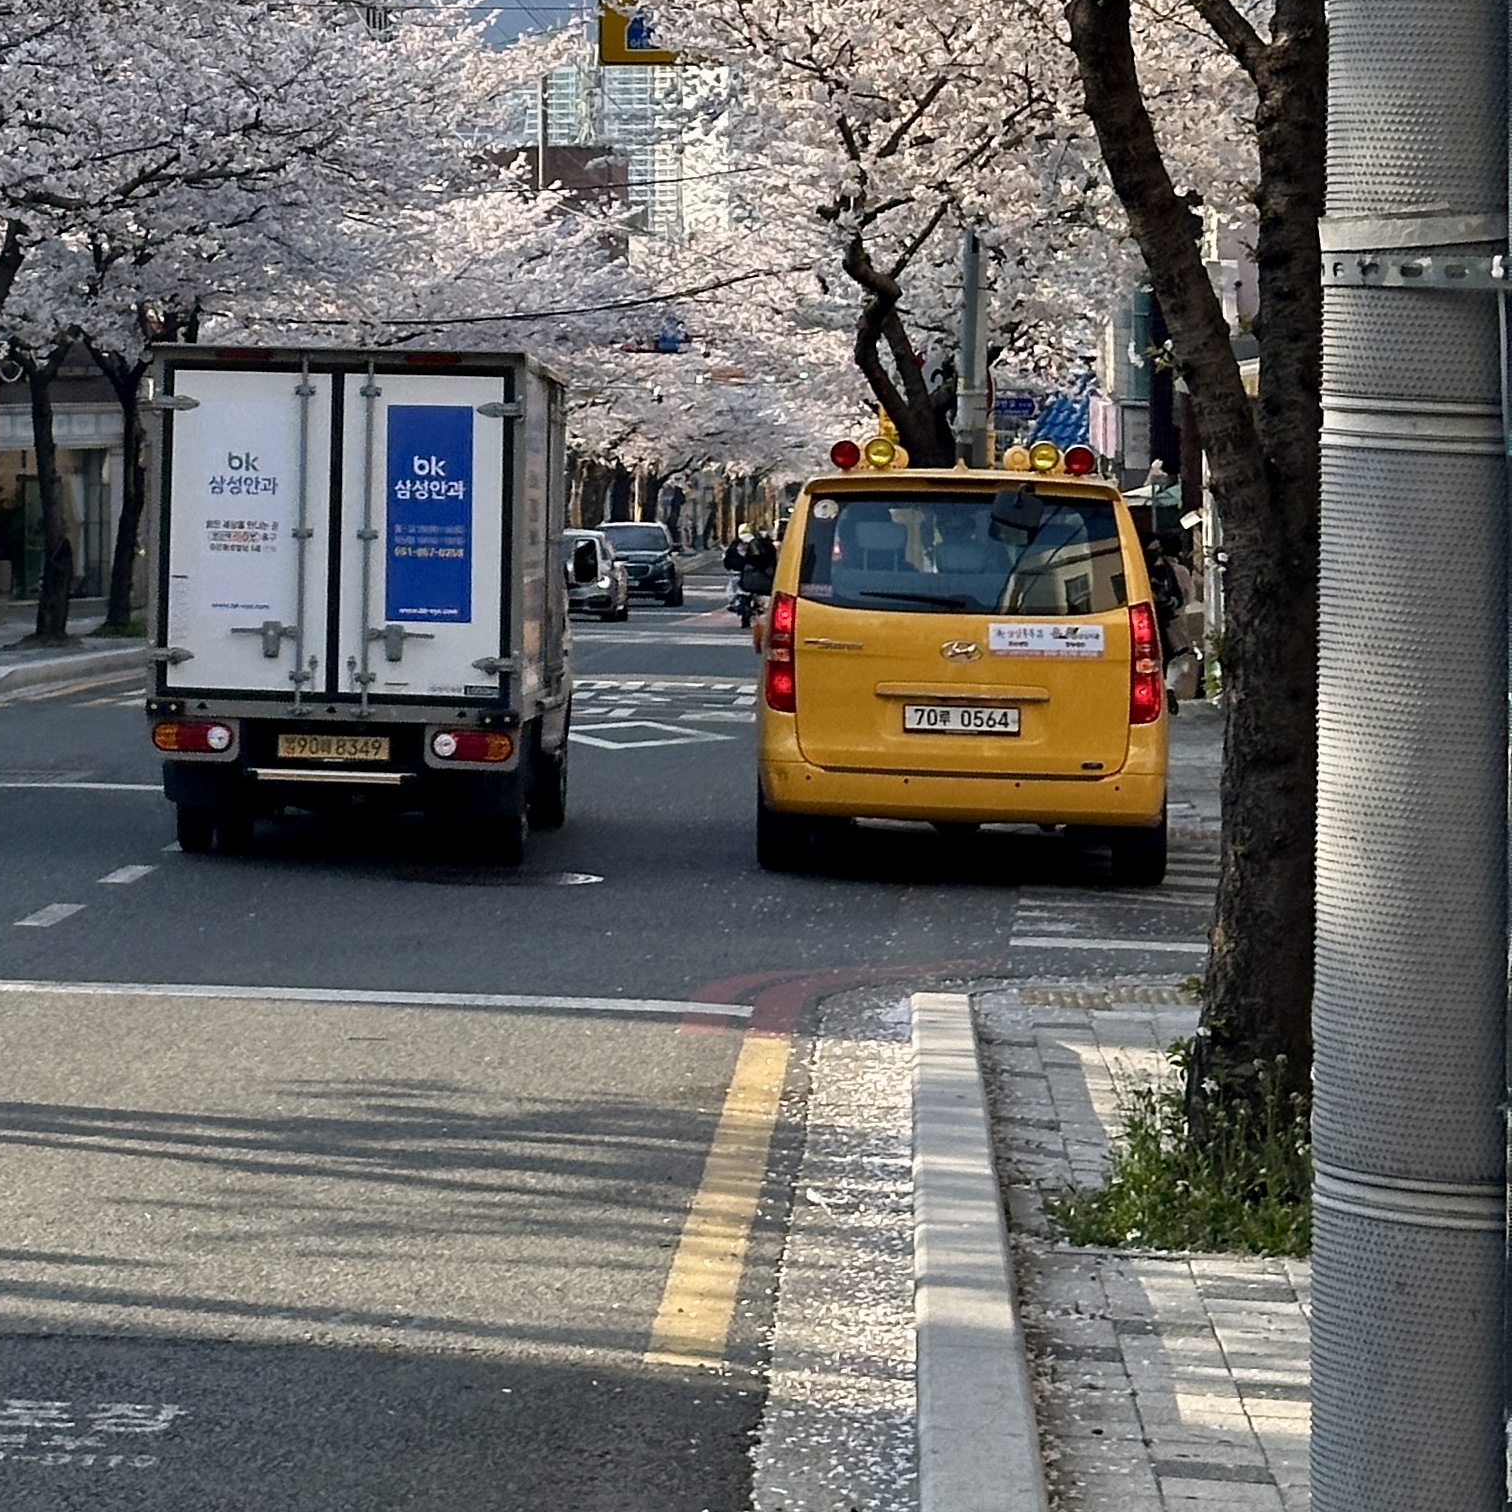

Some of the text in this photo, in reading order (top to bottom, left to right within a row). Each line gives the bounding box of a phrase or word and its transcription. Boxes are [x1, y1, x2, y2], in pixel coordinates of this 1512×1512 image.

[227, 450, 260, 473] bk
[412, 455, 447, 477] bk
[208, 474, 279, 496] 삼성안과
[394, 479, 466, 500] 삼성안과
[913, 707, 1010, 729] 70루 0564
[335, 737, 382, 757] 8349
